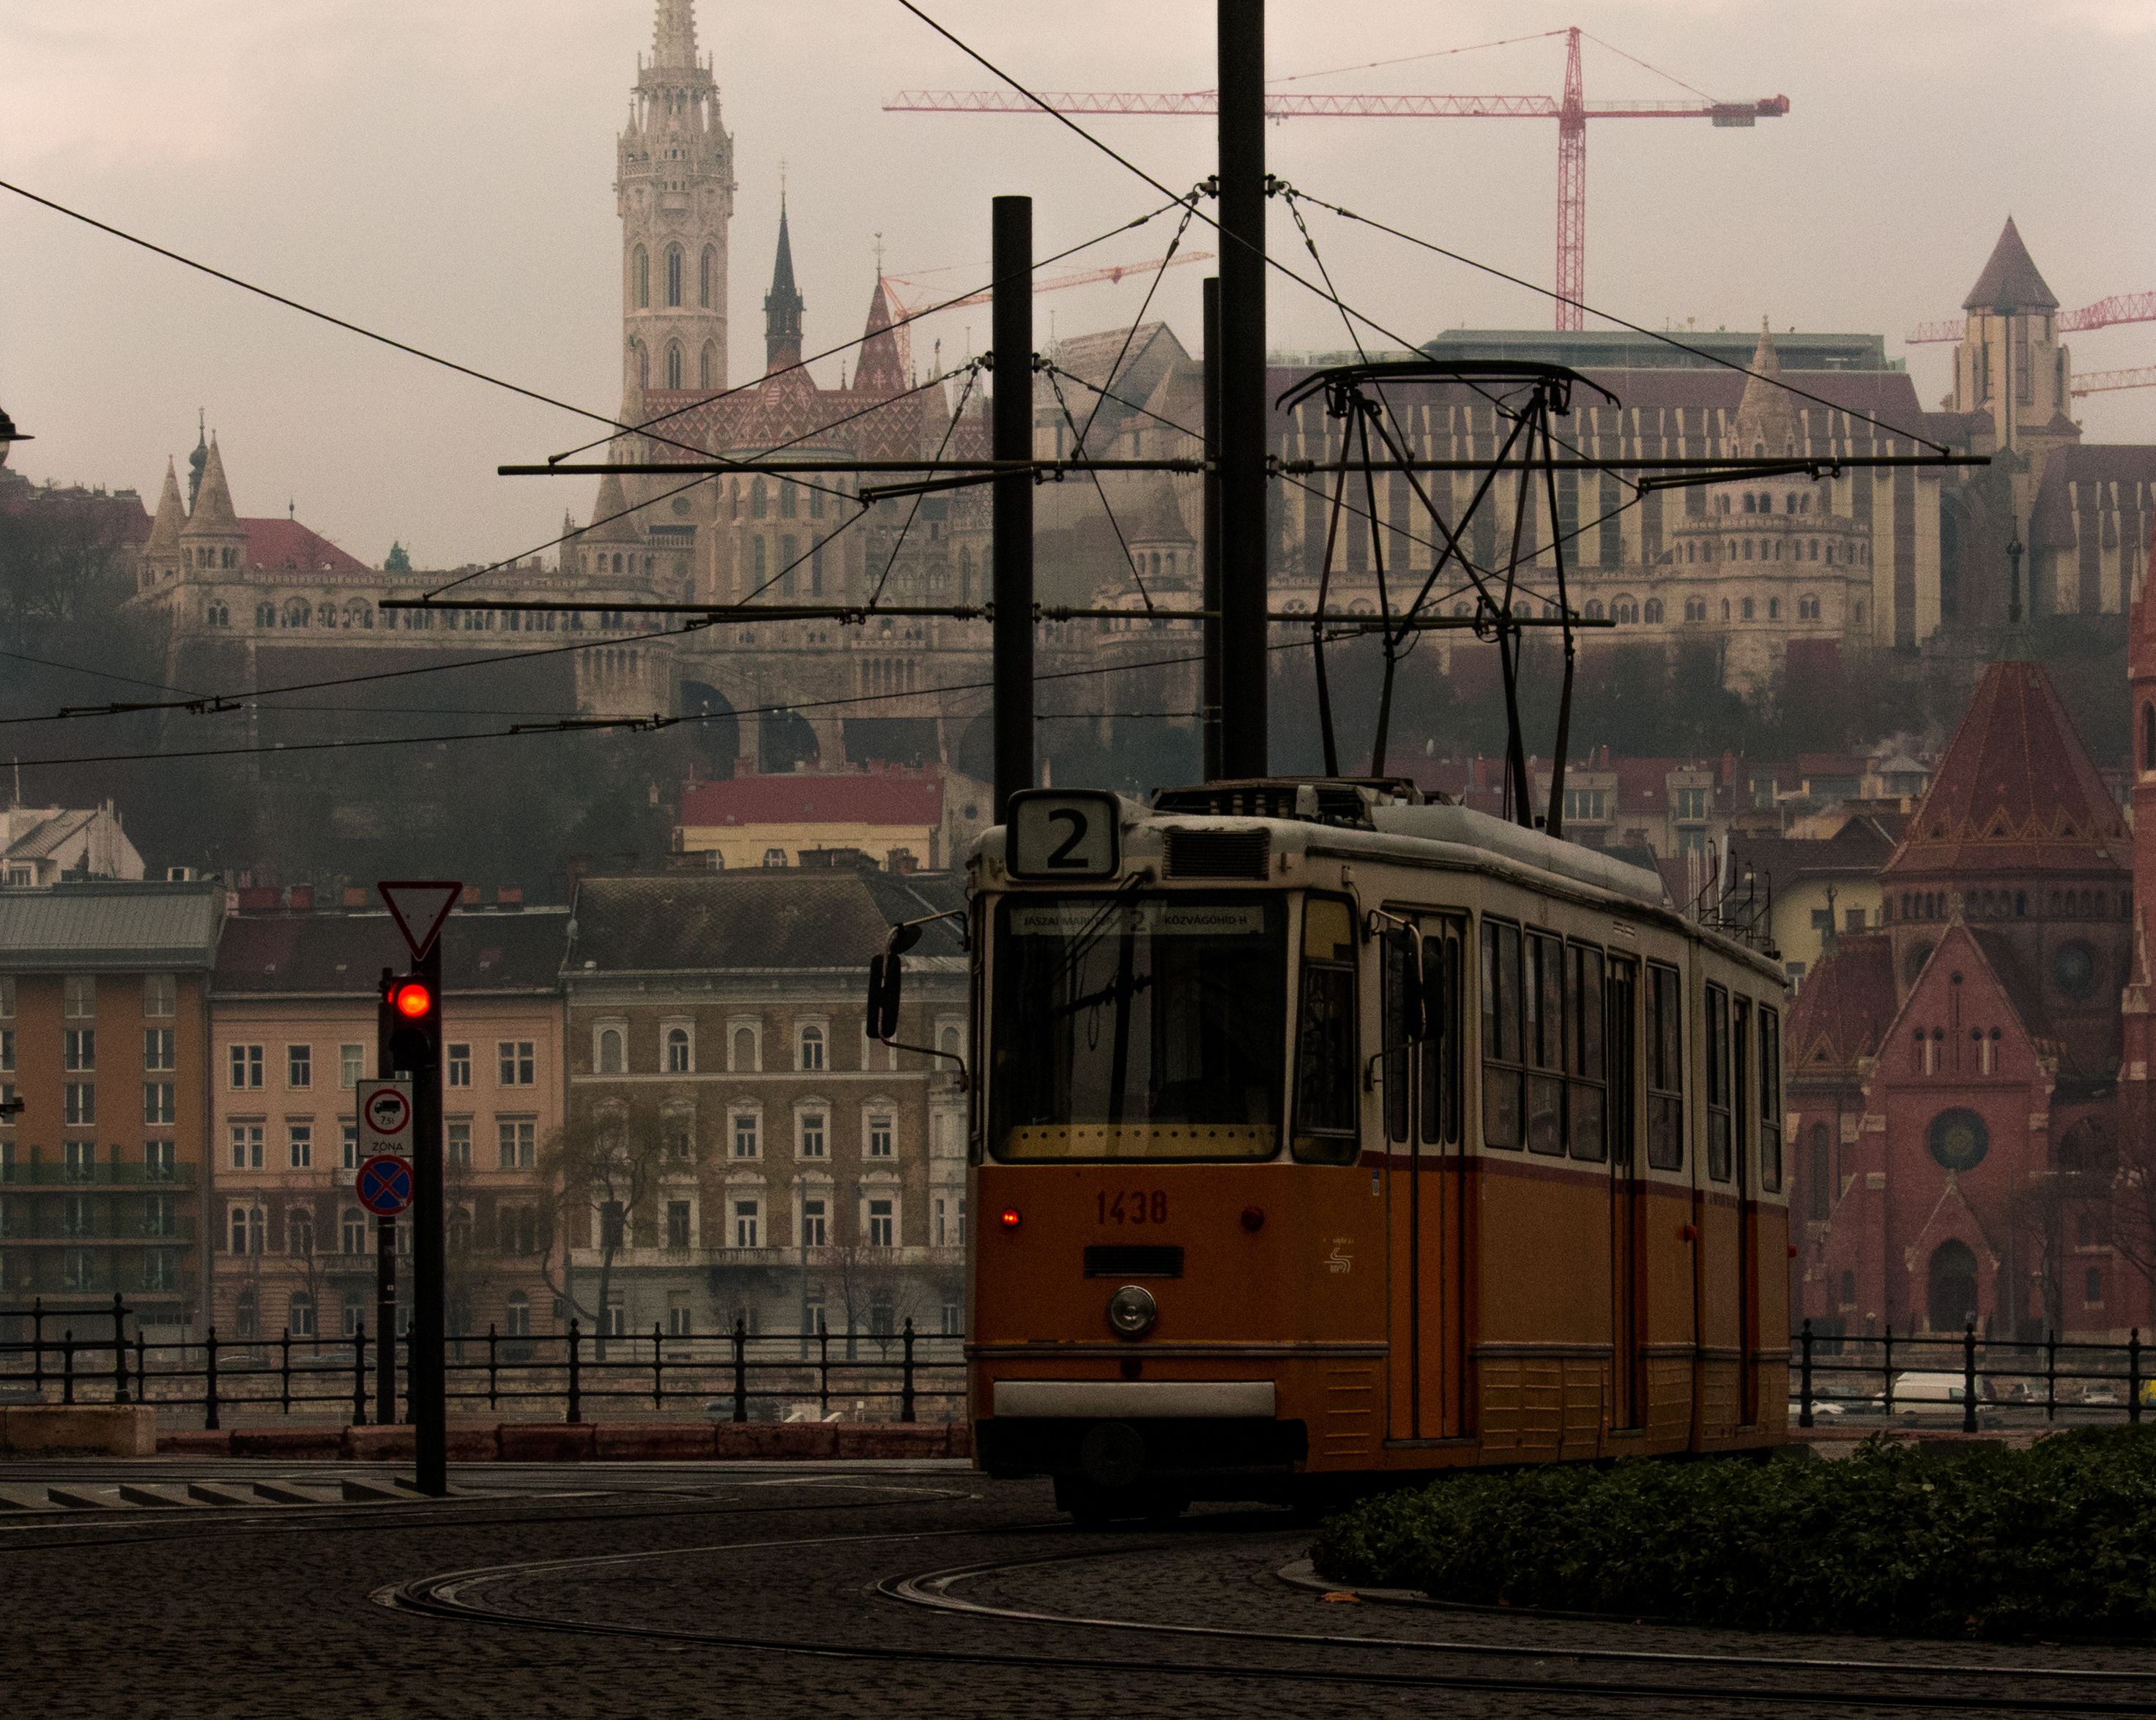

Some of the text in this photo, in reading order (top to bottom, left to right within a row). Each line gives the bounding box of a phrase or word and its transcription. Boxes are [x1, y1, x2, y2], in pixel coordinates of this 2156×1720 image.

[1047, 808, 1088, 868] 2
[1129, 910, 1146, 932] 2
[372, 1140, 404, 1151] ZÓNA
[1096, 1190, 1167, 1225] 1438
